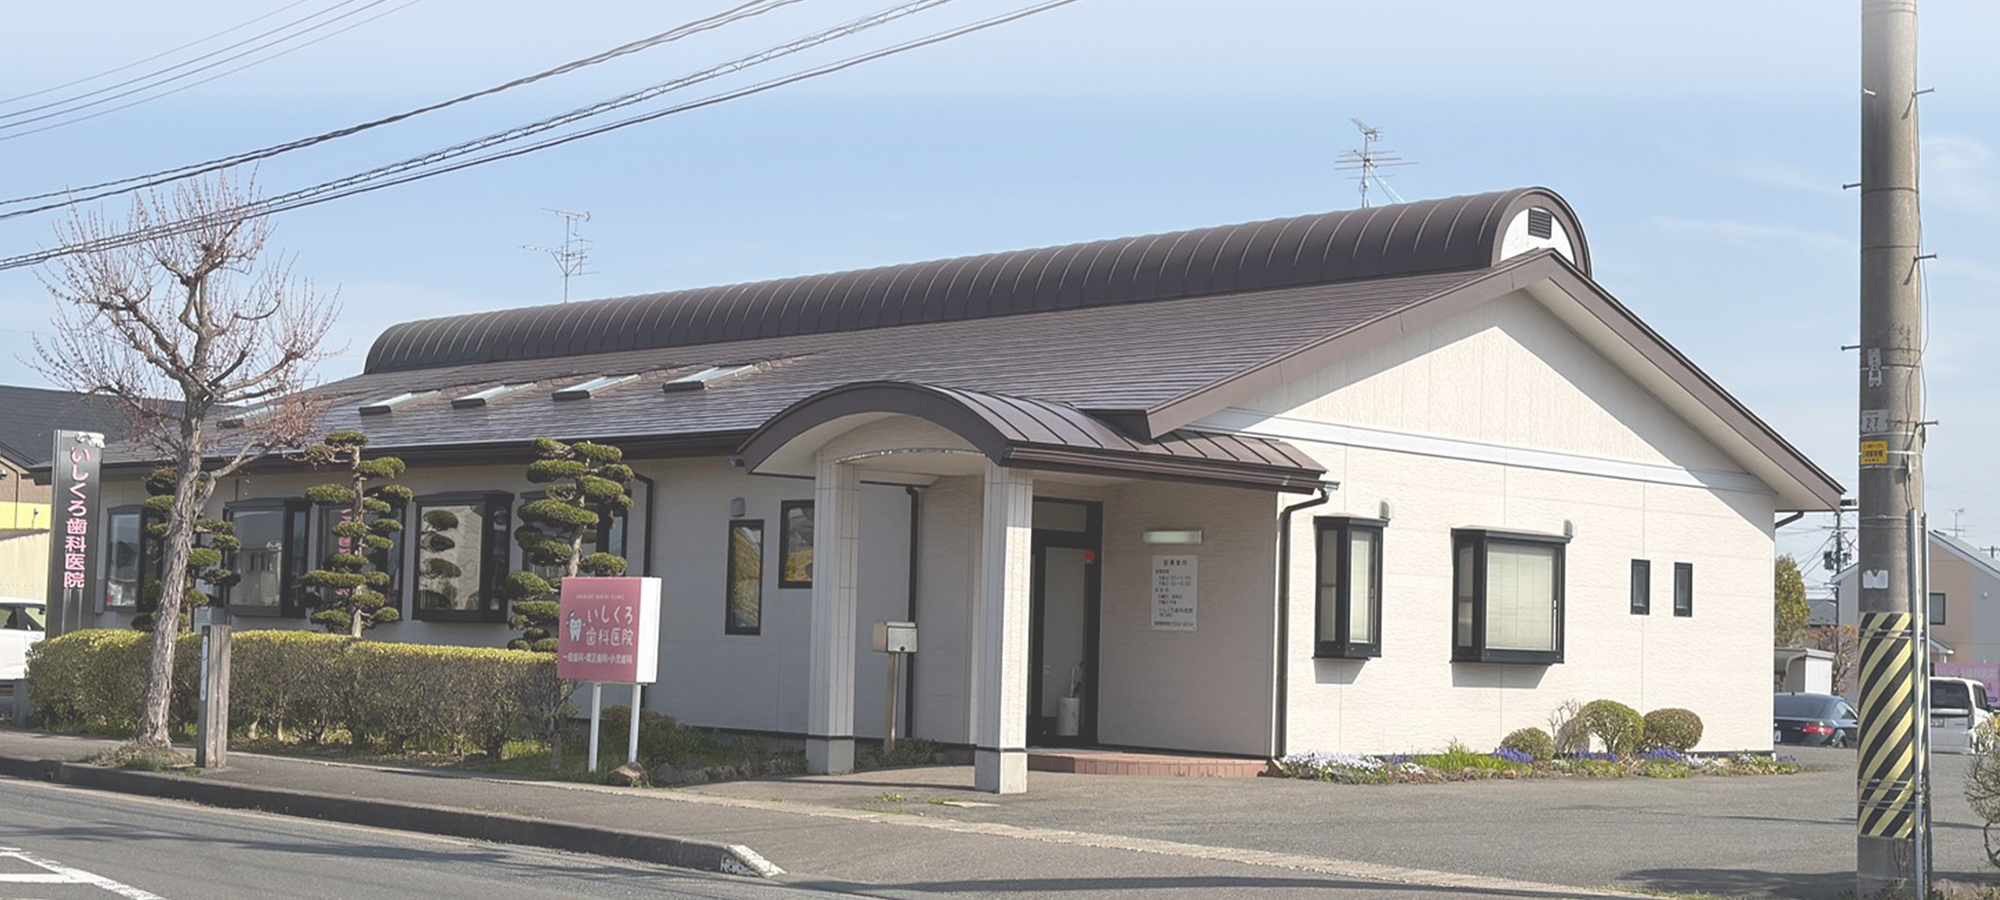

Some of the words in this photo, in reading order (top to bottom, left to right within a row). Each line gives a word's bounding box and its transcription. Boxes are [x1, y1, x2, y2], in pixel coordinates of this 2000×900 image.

[1866, 417, 1879, 428] 27
[63, 446, 91, 589] いしくろ歯科医院
[587, 604, 634, 625] いしくろ
[586, 627, 634, 647] 歯科医院
